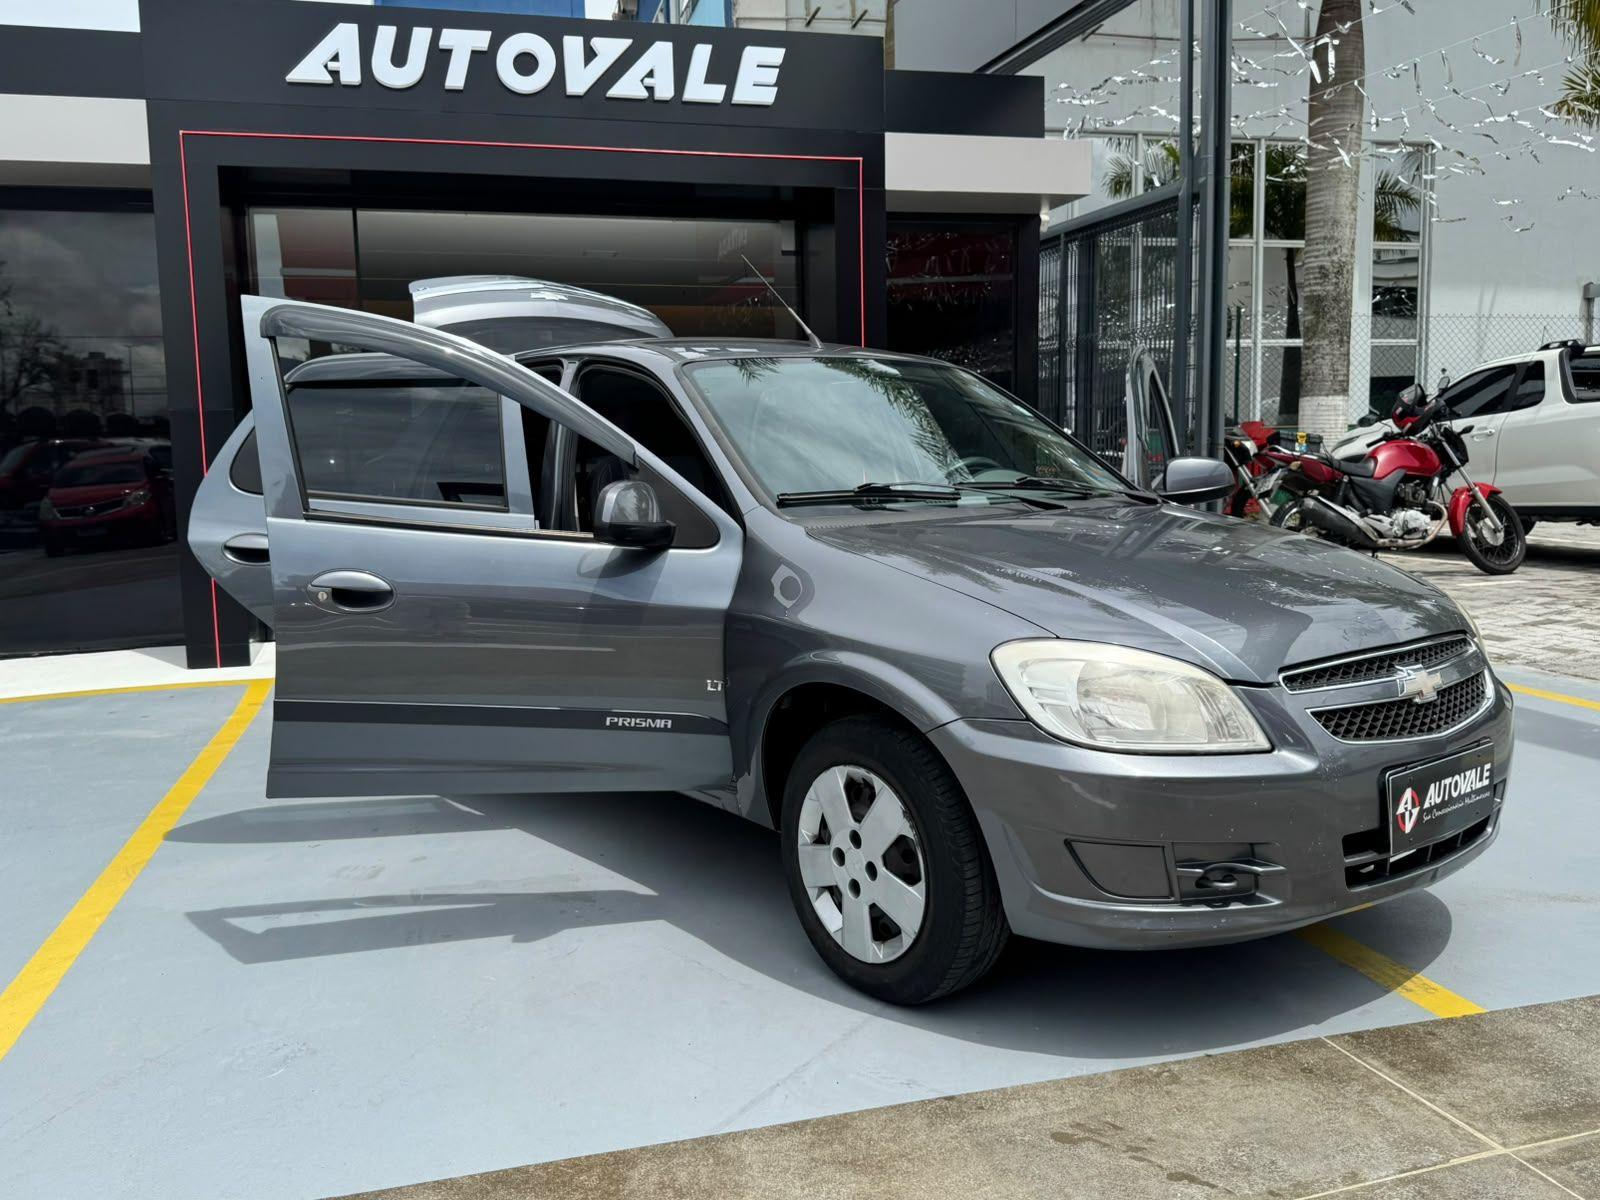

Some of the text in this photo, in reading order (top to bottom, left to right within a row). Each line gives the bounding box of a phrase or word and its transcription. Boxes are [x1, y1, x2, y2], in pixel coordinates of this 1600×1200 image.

[285, 22, 787, 106] AUTOVALE
[706, 679, 724, 691] LT
[605, 716, 672, 729] PRISMA
[1423, 763, 1491, 809] AUTOVALE
